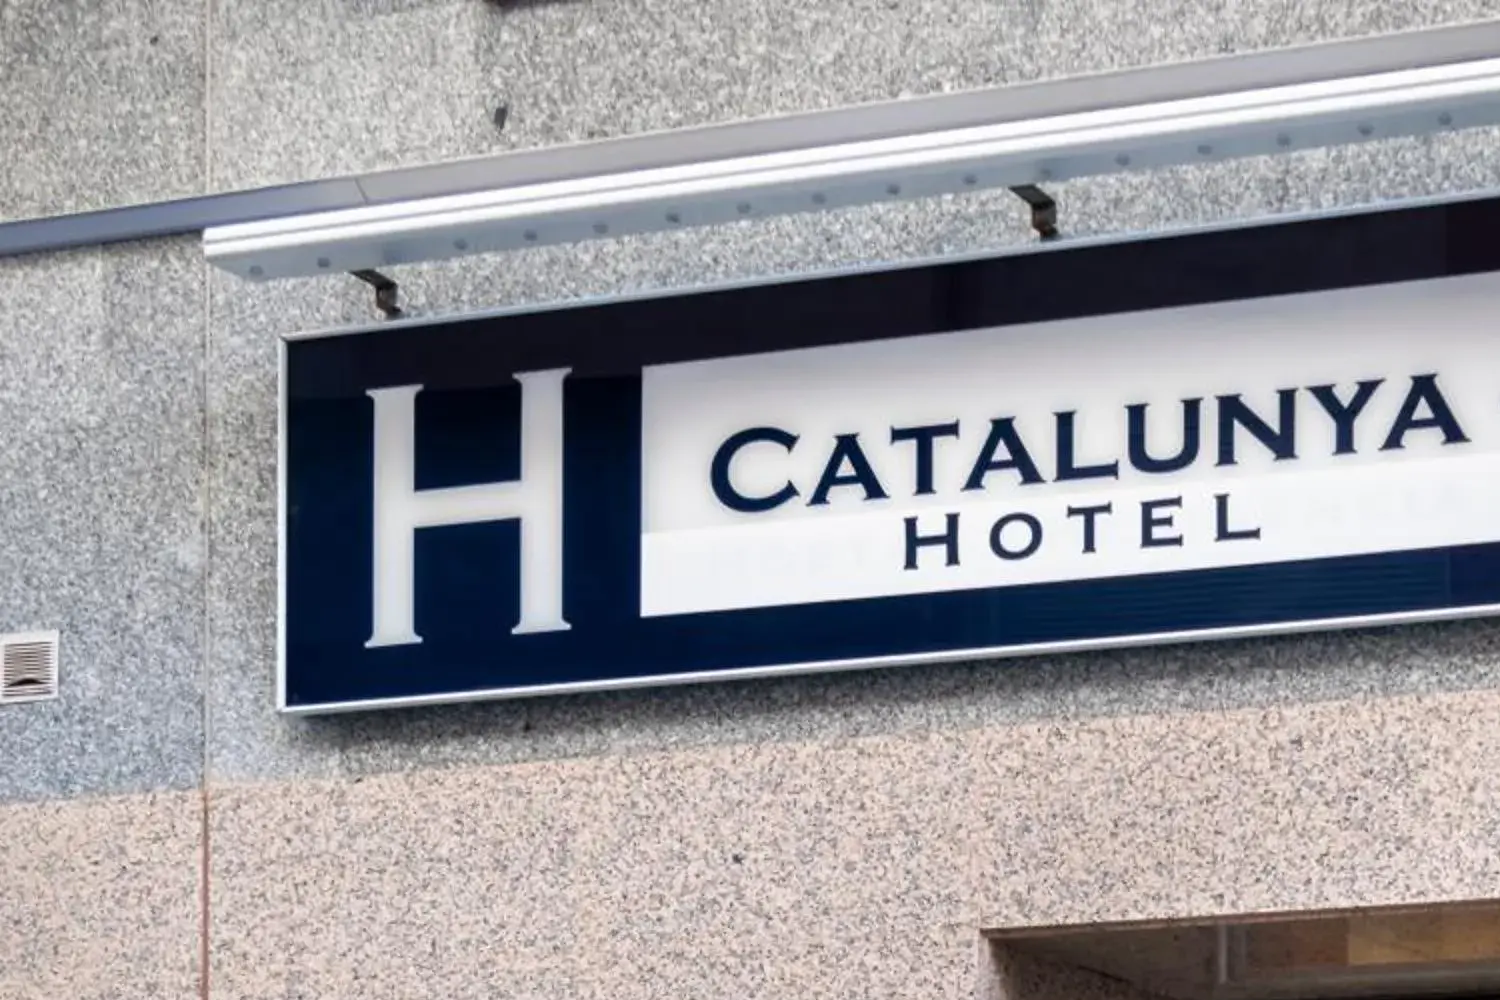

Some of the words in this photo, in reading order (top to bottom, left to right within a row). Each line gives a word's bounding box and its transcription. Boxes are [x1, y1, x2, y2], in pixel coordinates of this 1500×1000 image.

[363, 367, 573, 649] H
[709, 373, 1471, 513] CATALUNYA
[903, 492, 1262, 571] HOTEL
